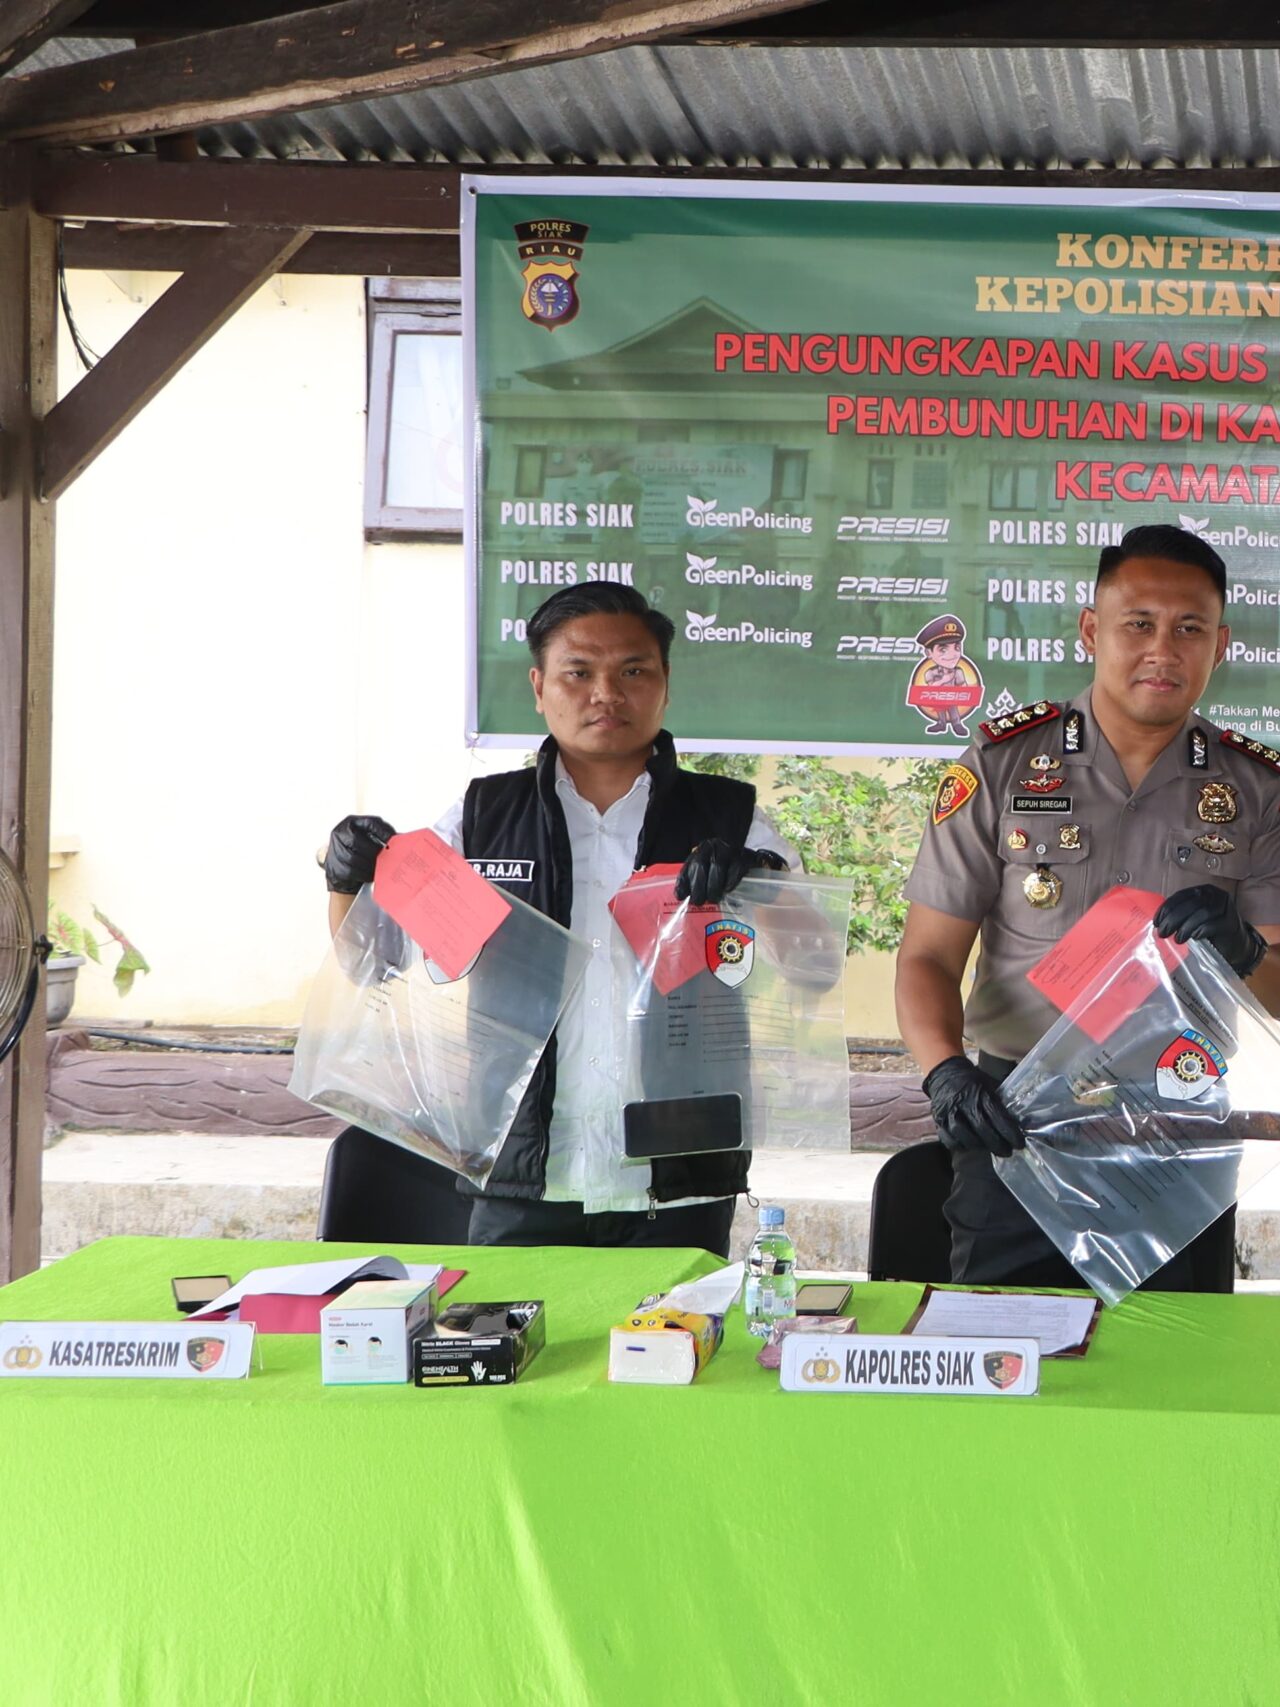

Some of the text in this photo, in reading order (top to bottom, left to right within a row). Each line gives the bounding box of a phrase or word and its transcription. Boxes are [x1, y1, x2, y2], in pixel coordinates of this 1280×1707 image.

[530, 222, 572, 232] POLRES
[525, 245, 576, 255] RIAU
[714, 332, 1099, 379] PENGUNGKAPAN
[1113, 341, 1268, 384] KASUS
[827, 395, 1147, 441] PEMBUNUHAN
[1160, 402, 1201, 442] DI
[501, 502, 578, 526] POLRES
[586, 503, 634, 528] SIAK
[836, 516, 950, 535] PRESISI
[988, 520, 1124, 546] POLRES SIAK
[501, 560, 634, 585] POLRES SIAK
[836, 576, 949, 595] PRESISI
[988, 579, 1095, 604] POLRES SI
[988, 637, 1065, 662] POLRES
[920, 690, 972, 702] PRESISI
[1209, 704, 1258, 716] #Takkan
[1250, 721, 1262, 731] di
[1016, 799, 1068, 810] SEPUH SIREGAR
[1190, 1032, 1226, 1069] INAFIS
[49, 1340, 180, 1367] KASATRESKRIM
[845, 1349, 975, 1386] KAPOLRES SIAK
